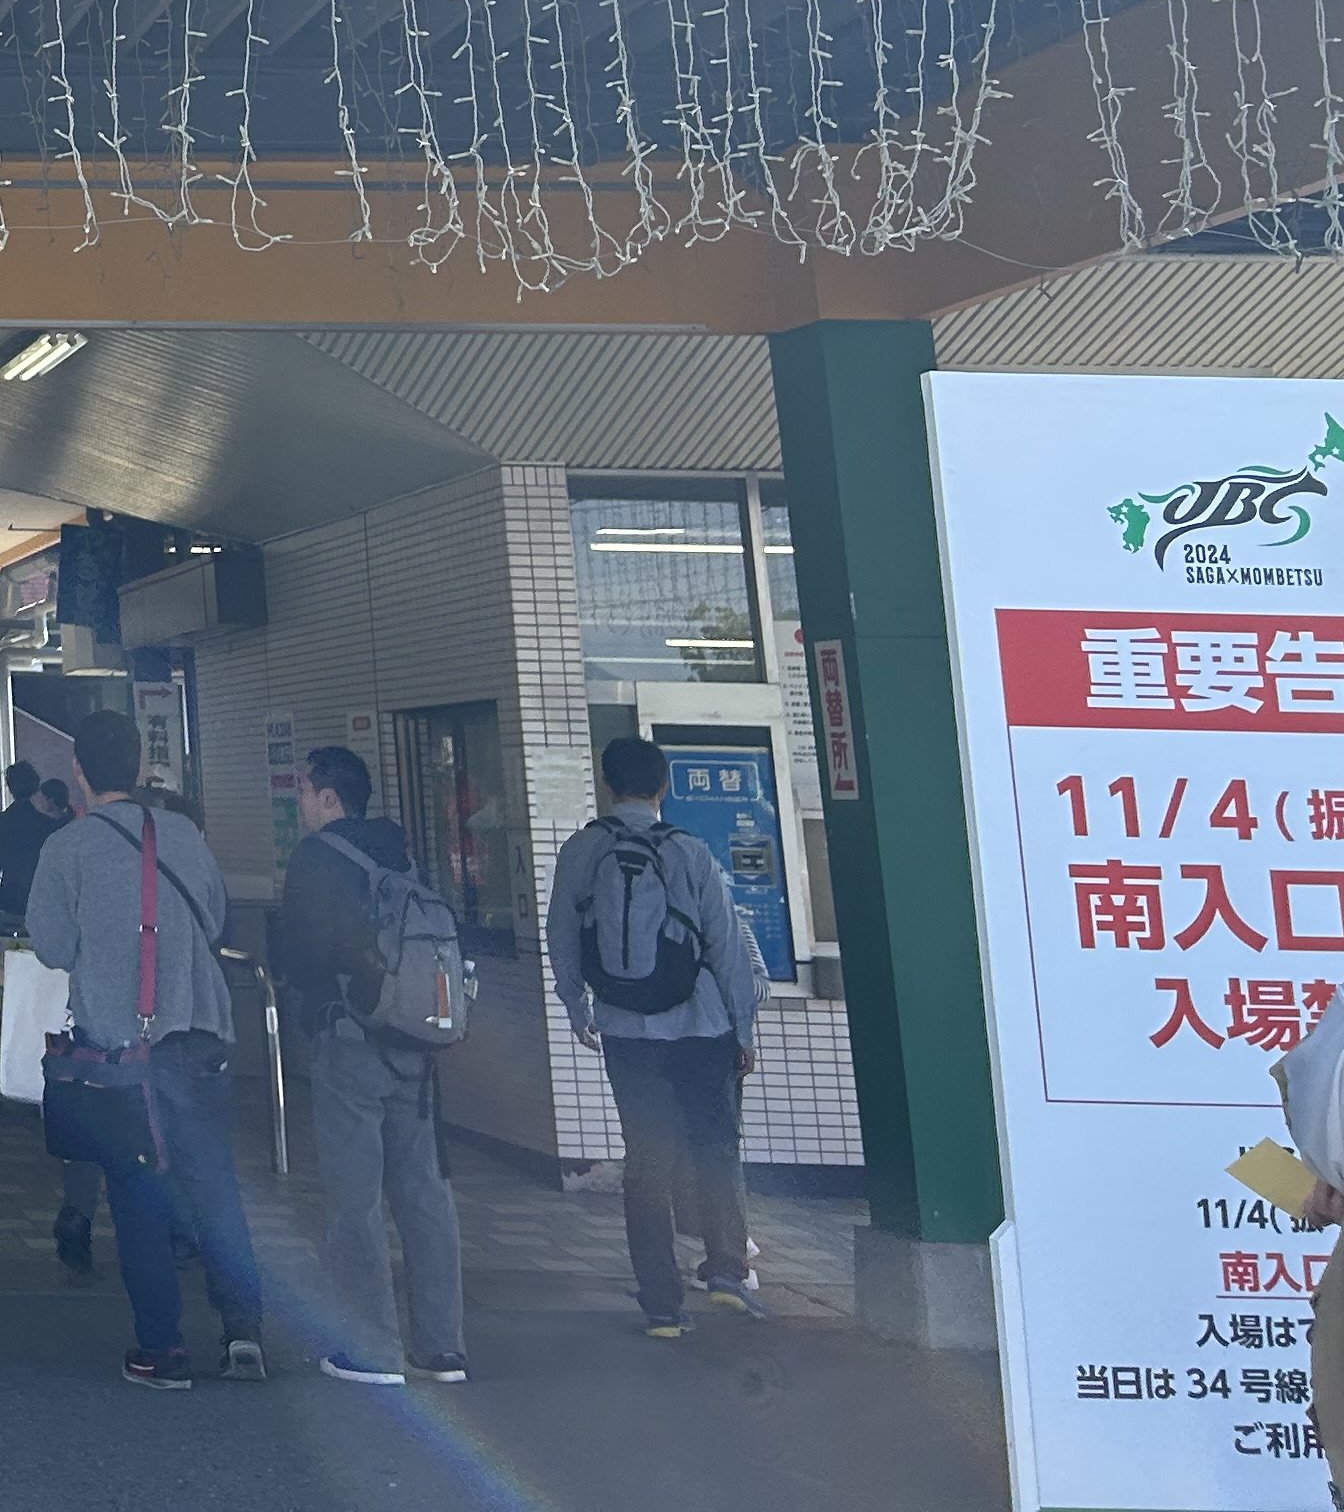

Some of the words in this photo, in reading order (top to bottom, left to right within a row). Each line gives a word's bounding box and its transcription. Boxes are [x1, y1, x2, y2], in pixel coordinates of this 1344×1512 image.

[1183, 543, 1231, 565] 2024
[1080, 626, 1344, 715] 重要告
[820, 648, 849, 771] 両替所
[686, 768, 742, 792] 両替
[1068, 859, 1344, 953] 南入口
[1076, 1365, 1175, 1401] 当日は
[1186, 1367, 1232, 1401] 34
[1240, 1368, 1312, 1403] 号線
